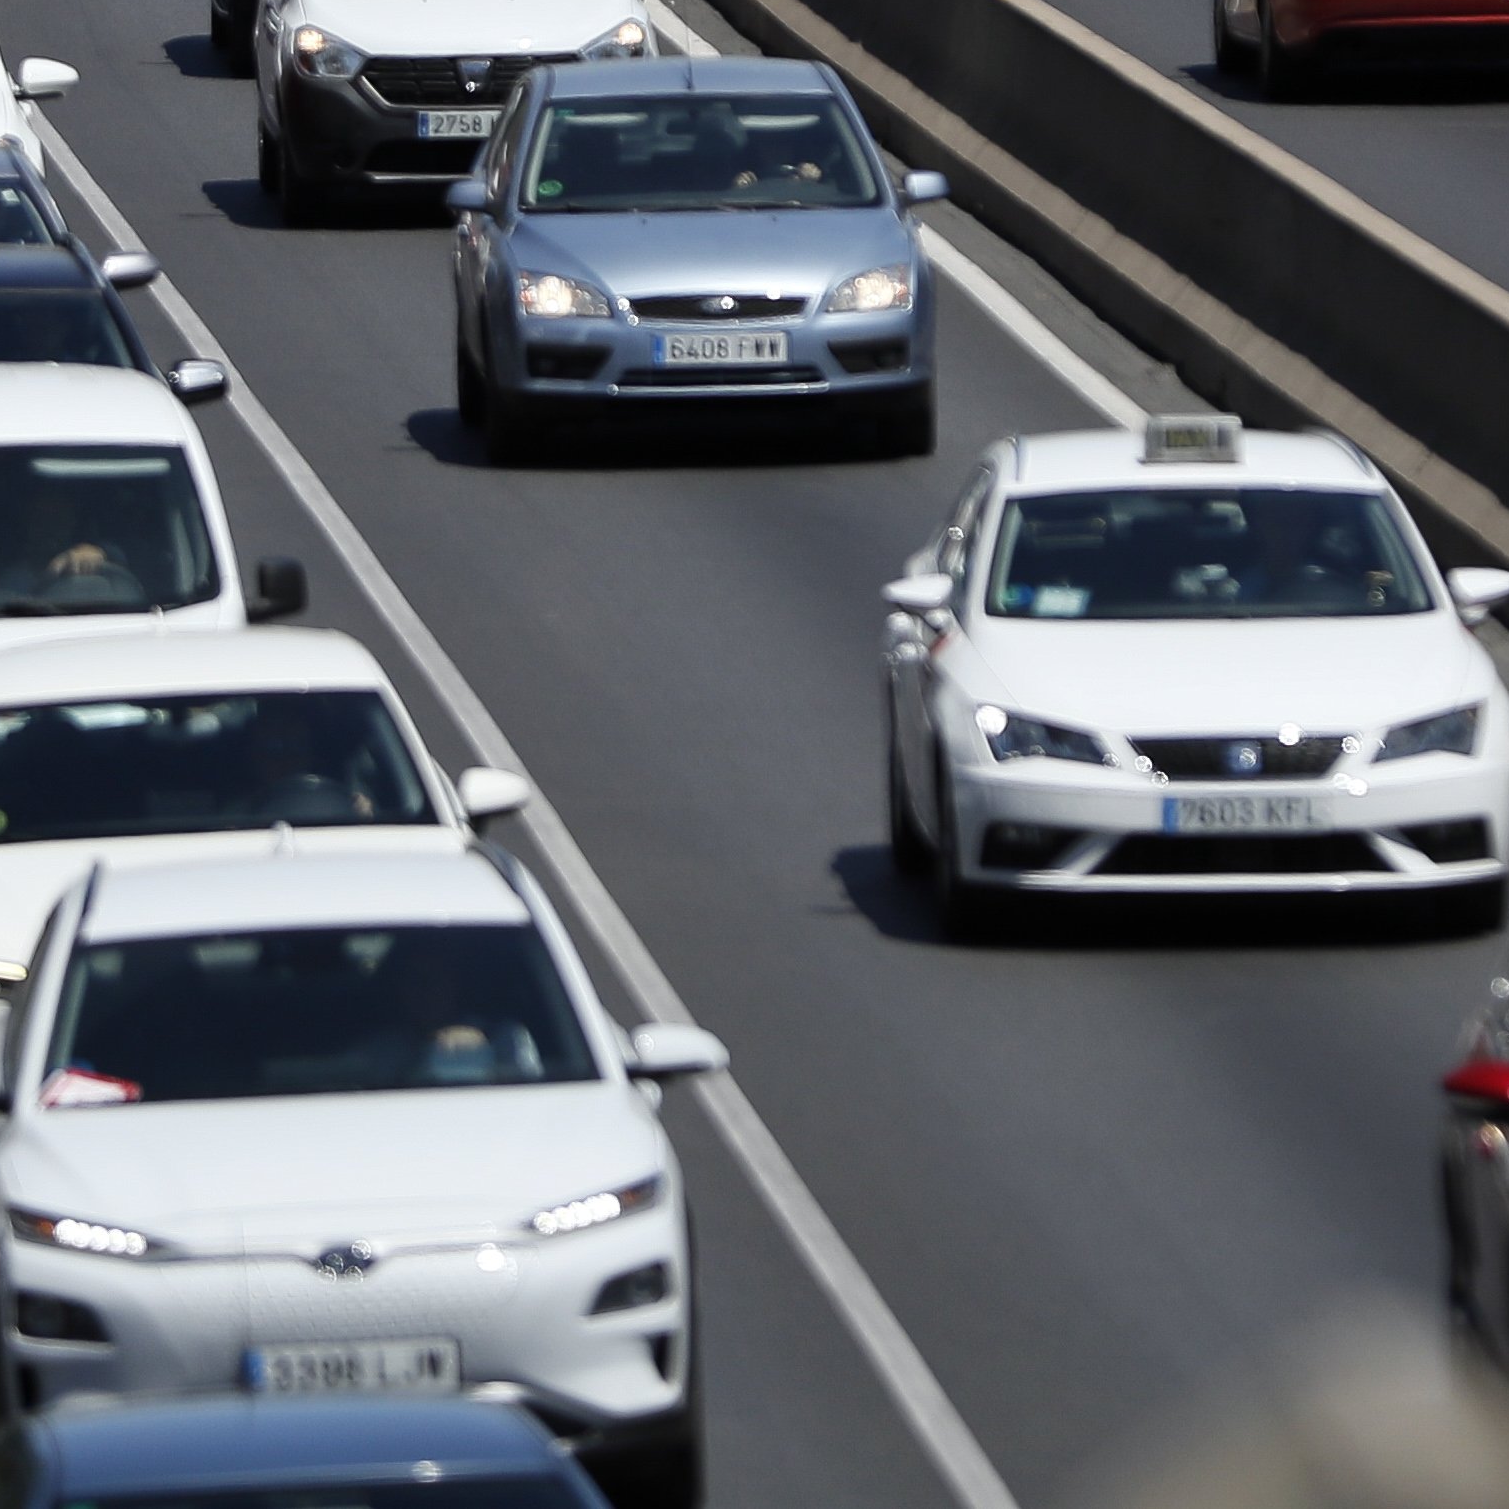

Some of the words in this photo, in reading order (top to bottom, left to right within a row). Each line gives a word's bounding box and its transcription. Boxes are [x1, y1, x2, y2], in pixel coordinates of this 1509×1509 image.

[432, 112, 480, 134] 2758
[671, 337, 729, 360] 6408
[1183, 796, 1255, 829] 7603
